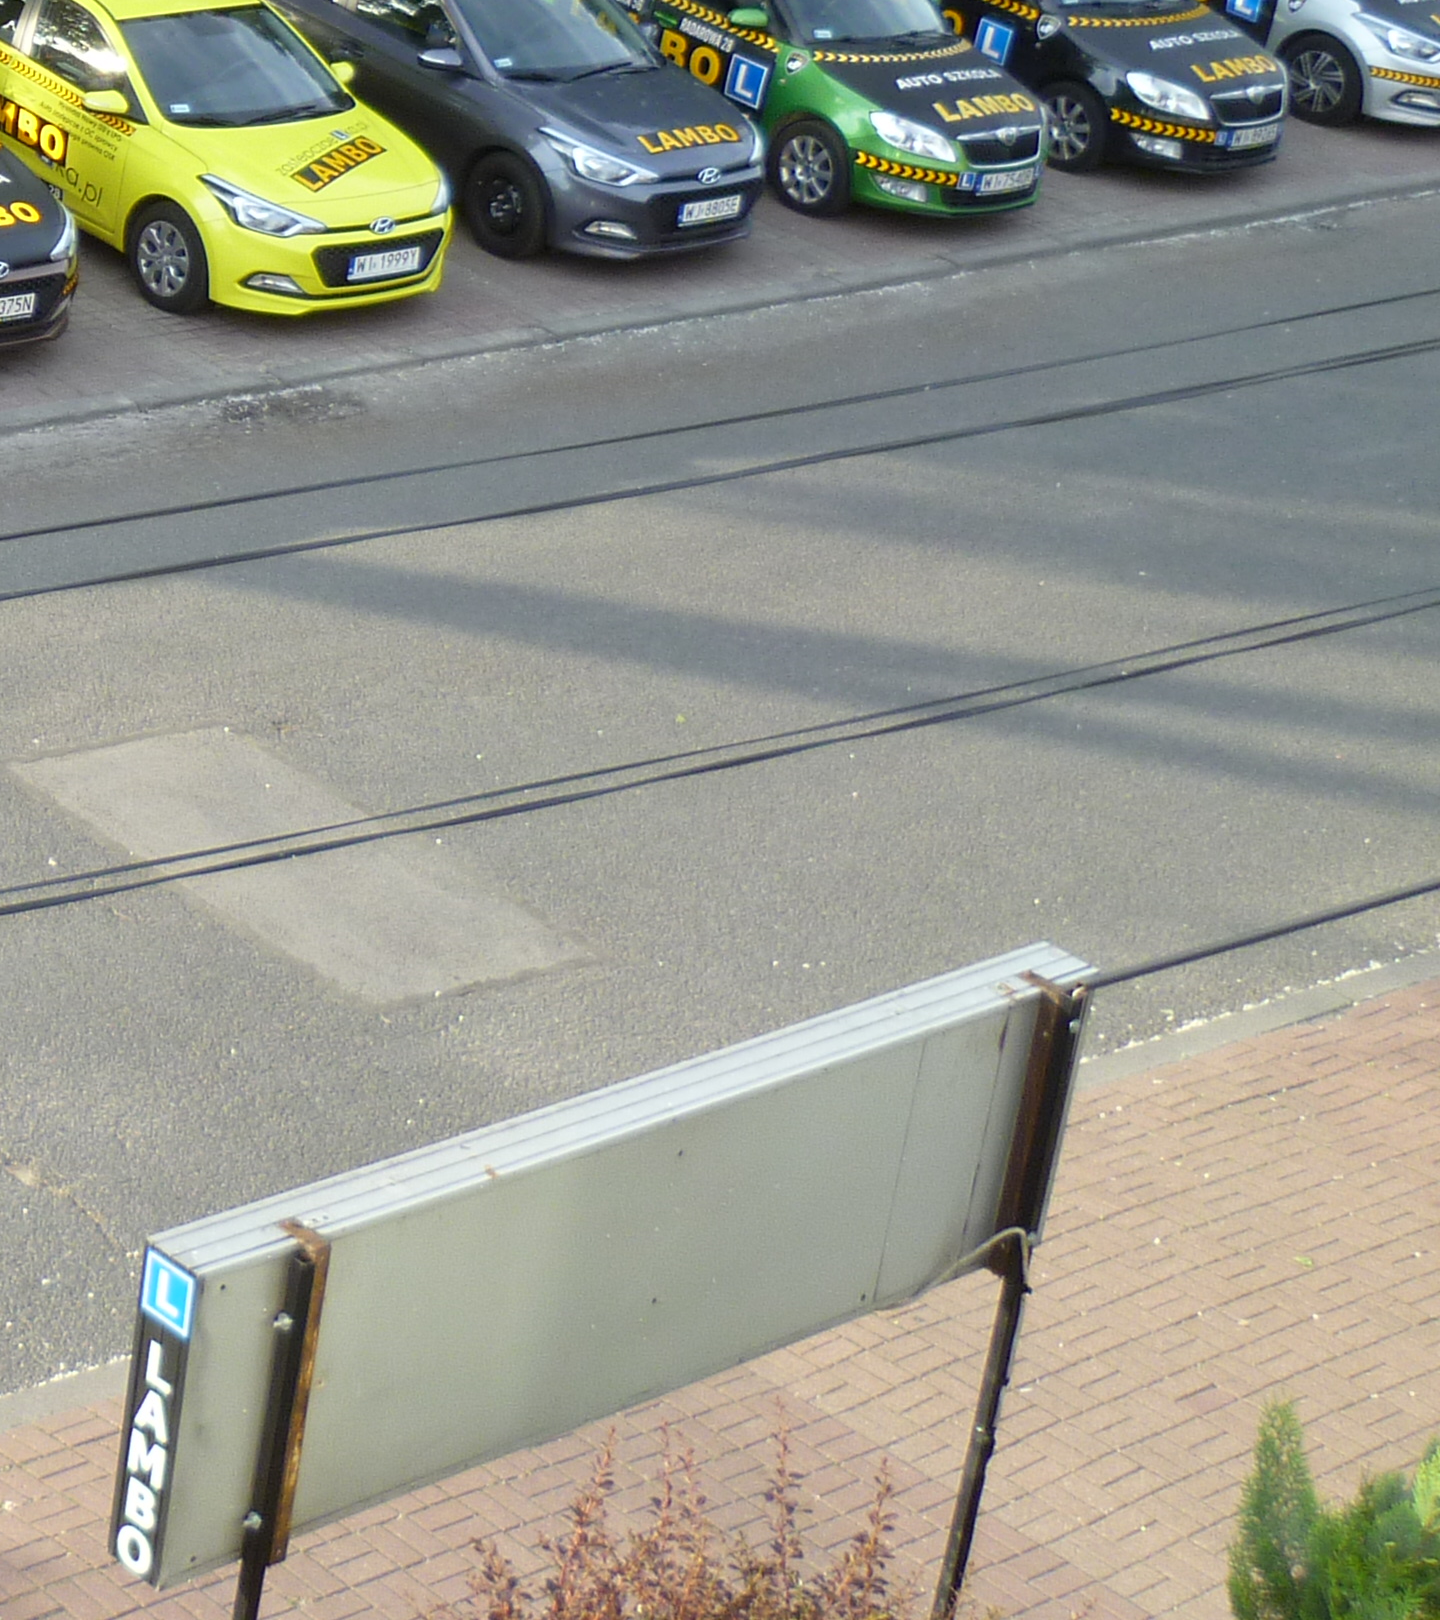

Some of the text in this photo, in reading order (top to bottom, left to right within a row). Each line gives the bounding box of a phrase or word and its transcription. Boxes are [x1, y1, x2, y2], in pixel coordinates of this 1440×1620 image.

[981, 25, 999, 58] L
[1149, 35, 1192, 50] AUTO
[734, 64, 753, 99] L
[896, 74, 942, 91] AUTO
[1191, 55, 1278, 82] LAMBO
[933, 93, 1036, 123] LAMBO
[637, 124, 741, 154] LAMBO
[293, 136, 383, 192] LAMBO
[381, 247, 418, 270] 1999Y
[155, 1267, 180, 1319] L
[116, 1338, 173, 1575] LAMBO
